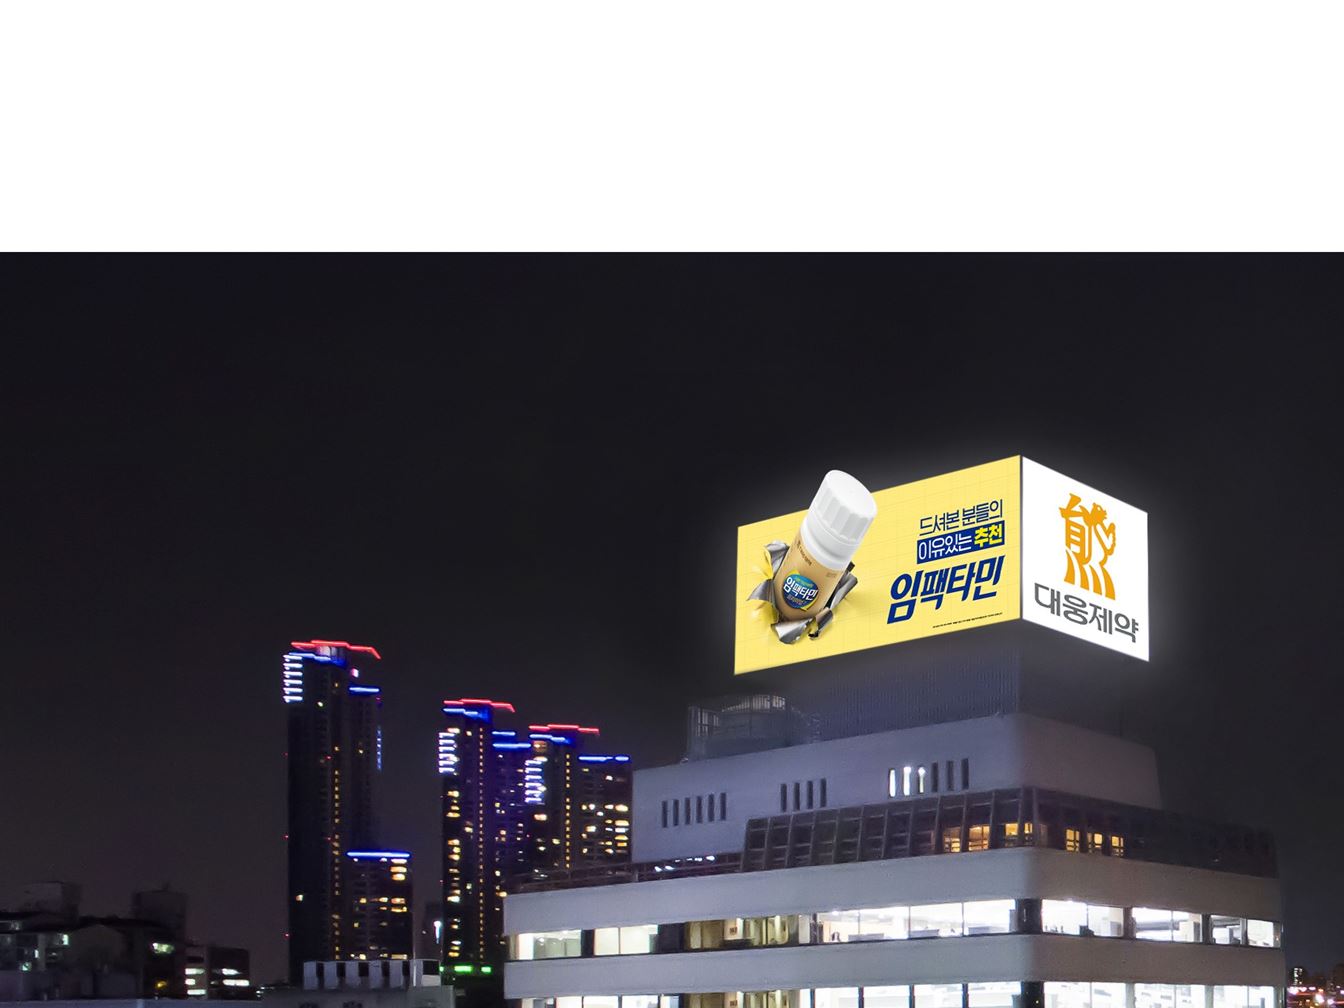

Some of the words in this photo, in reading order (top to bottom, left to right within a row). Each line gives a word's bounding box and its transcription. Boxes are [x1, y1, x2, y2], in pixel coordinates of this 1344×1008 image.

[919, 510, 960, 537] 드셔본
[962, 499, 1003, 526] 분들의
[918, 533, 973, 560] 이유있는
[974, 524, 1003, 548] 추천
[783, 577, 819, 601] 임팩타민
[887, 555, 1006, 625] 임팩타민
[1034, 582, 1140, 643] 대웅제약
